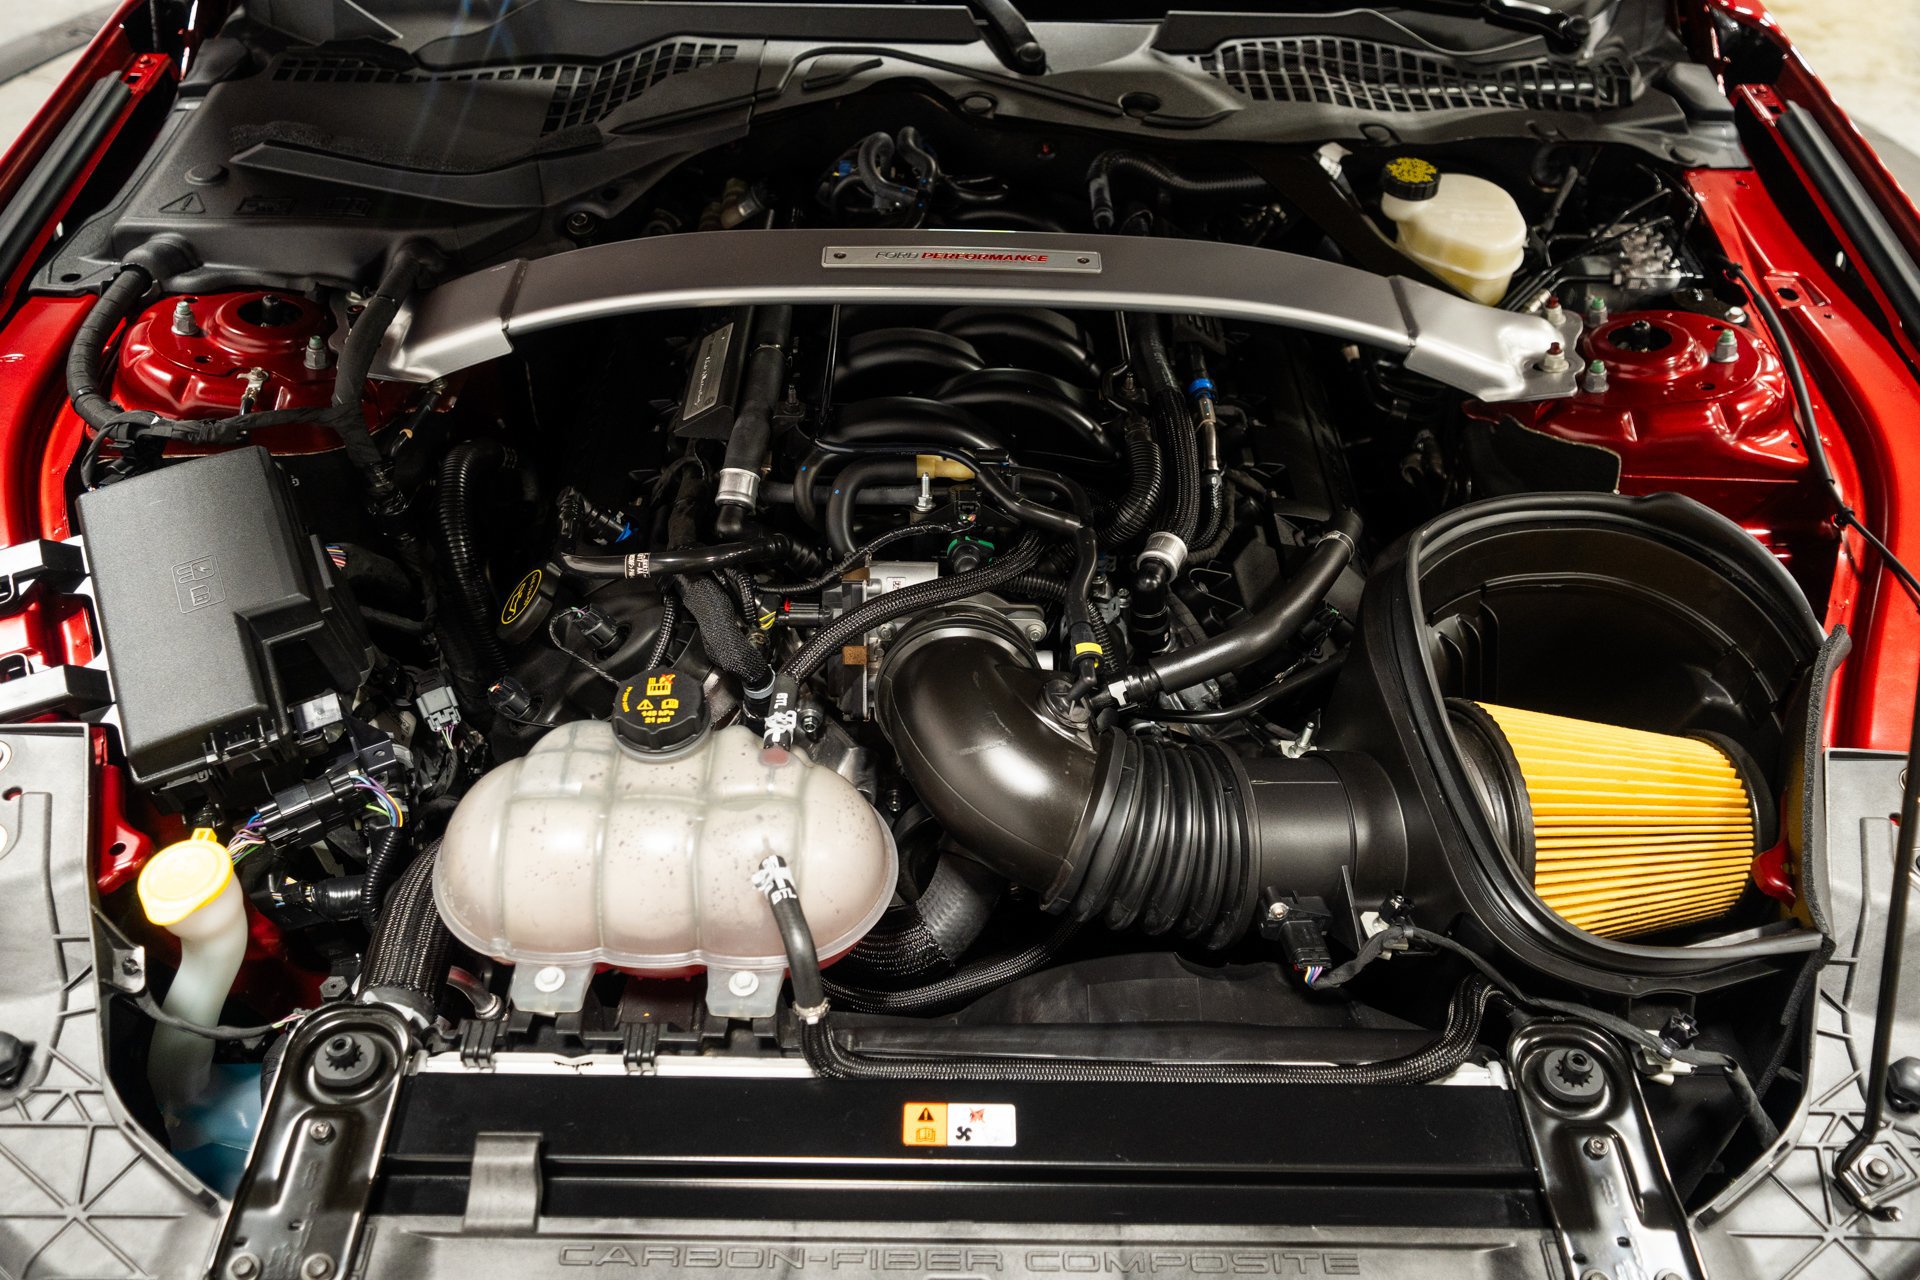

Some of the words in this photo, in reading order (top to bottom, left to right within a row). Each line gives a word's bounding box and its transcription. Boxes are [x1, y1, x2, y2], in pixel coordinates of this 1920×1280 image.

[875, 251, 919, 260] FORD
[921, 252, 1049, 263] PERFORMANCE
[557, 1244, 1004, 1271] CARBON-FIBER
[1024, 1250, 1361, 1275] COMPOSITE
